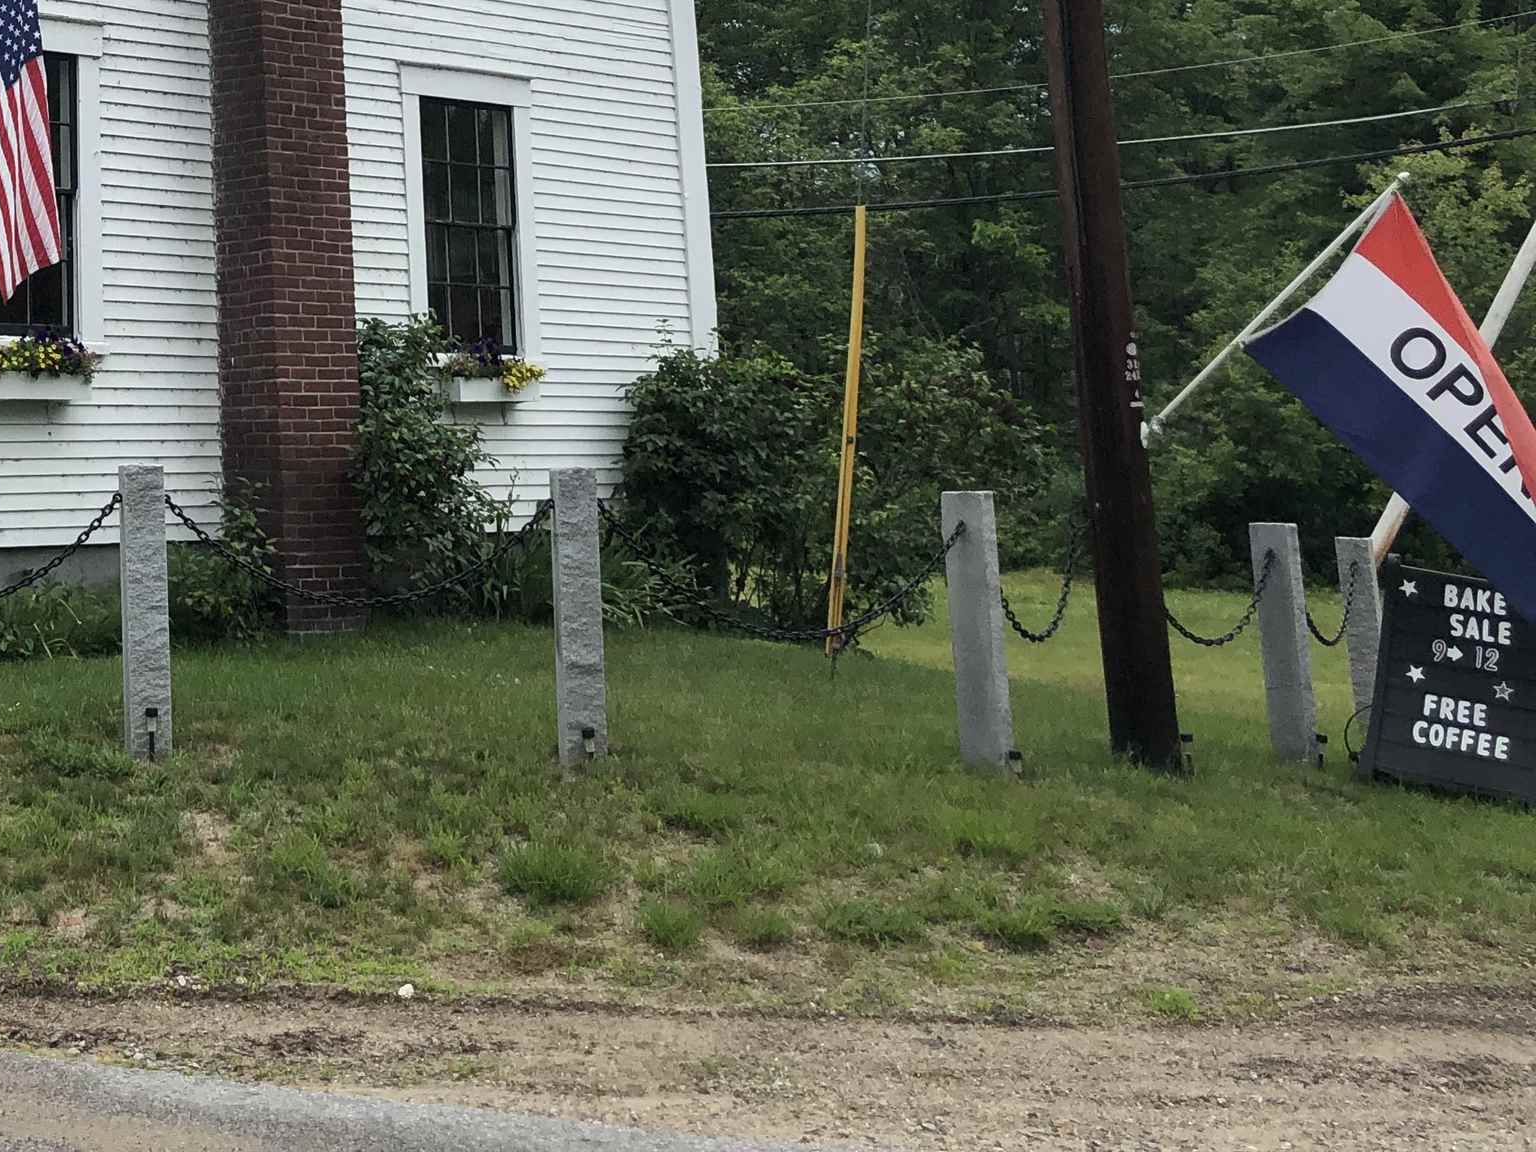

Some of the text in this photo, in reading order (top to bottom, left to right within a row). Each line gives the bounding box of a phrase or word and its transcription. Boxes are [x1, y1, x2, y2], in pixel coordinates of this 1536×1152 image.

[1443, 584, 1508, 616] BAKE
[1449, 613, 1513, 646] SALE
[1431, 639, 1500, 672] 9 12
[1423, 693, 1489, 727] FREE
[1412, 720, 1511, 760] COFFEE
